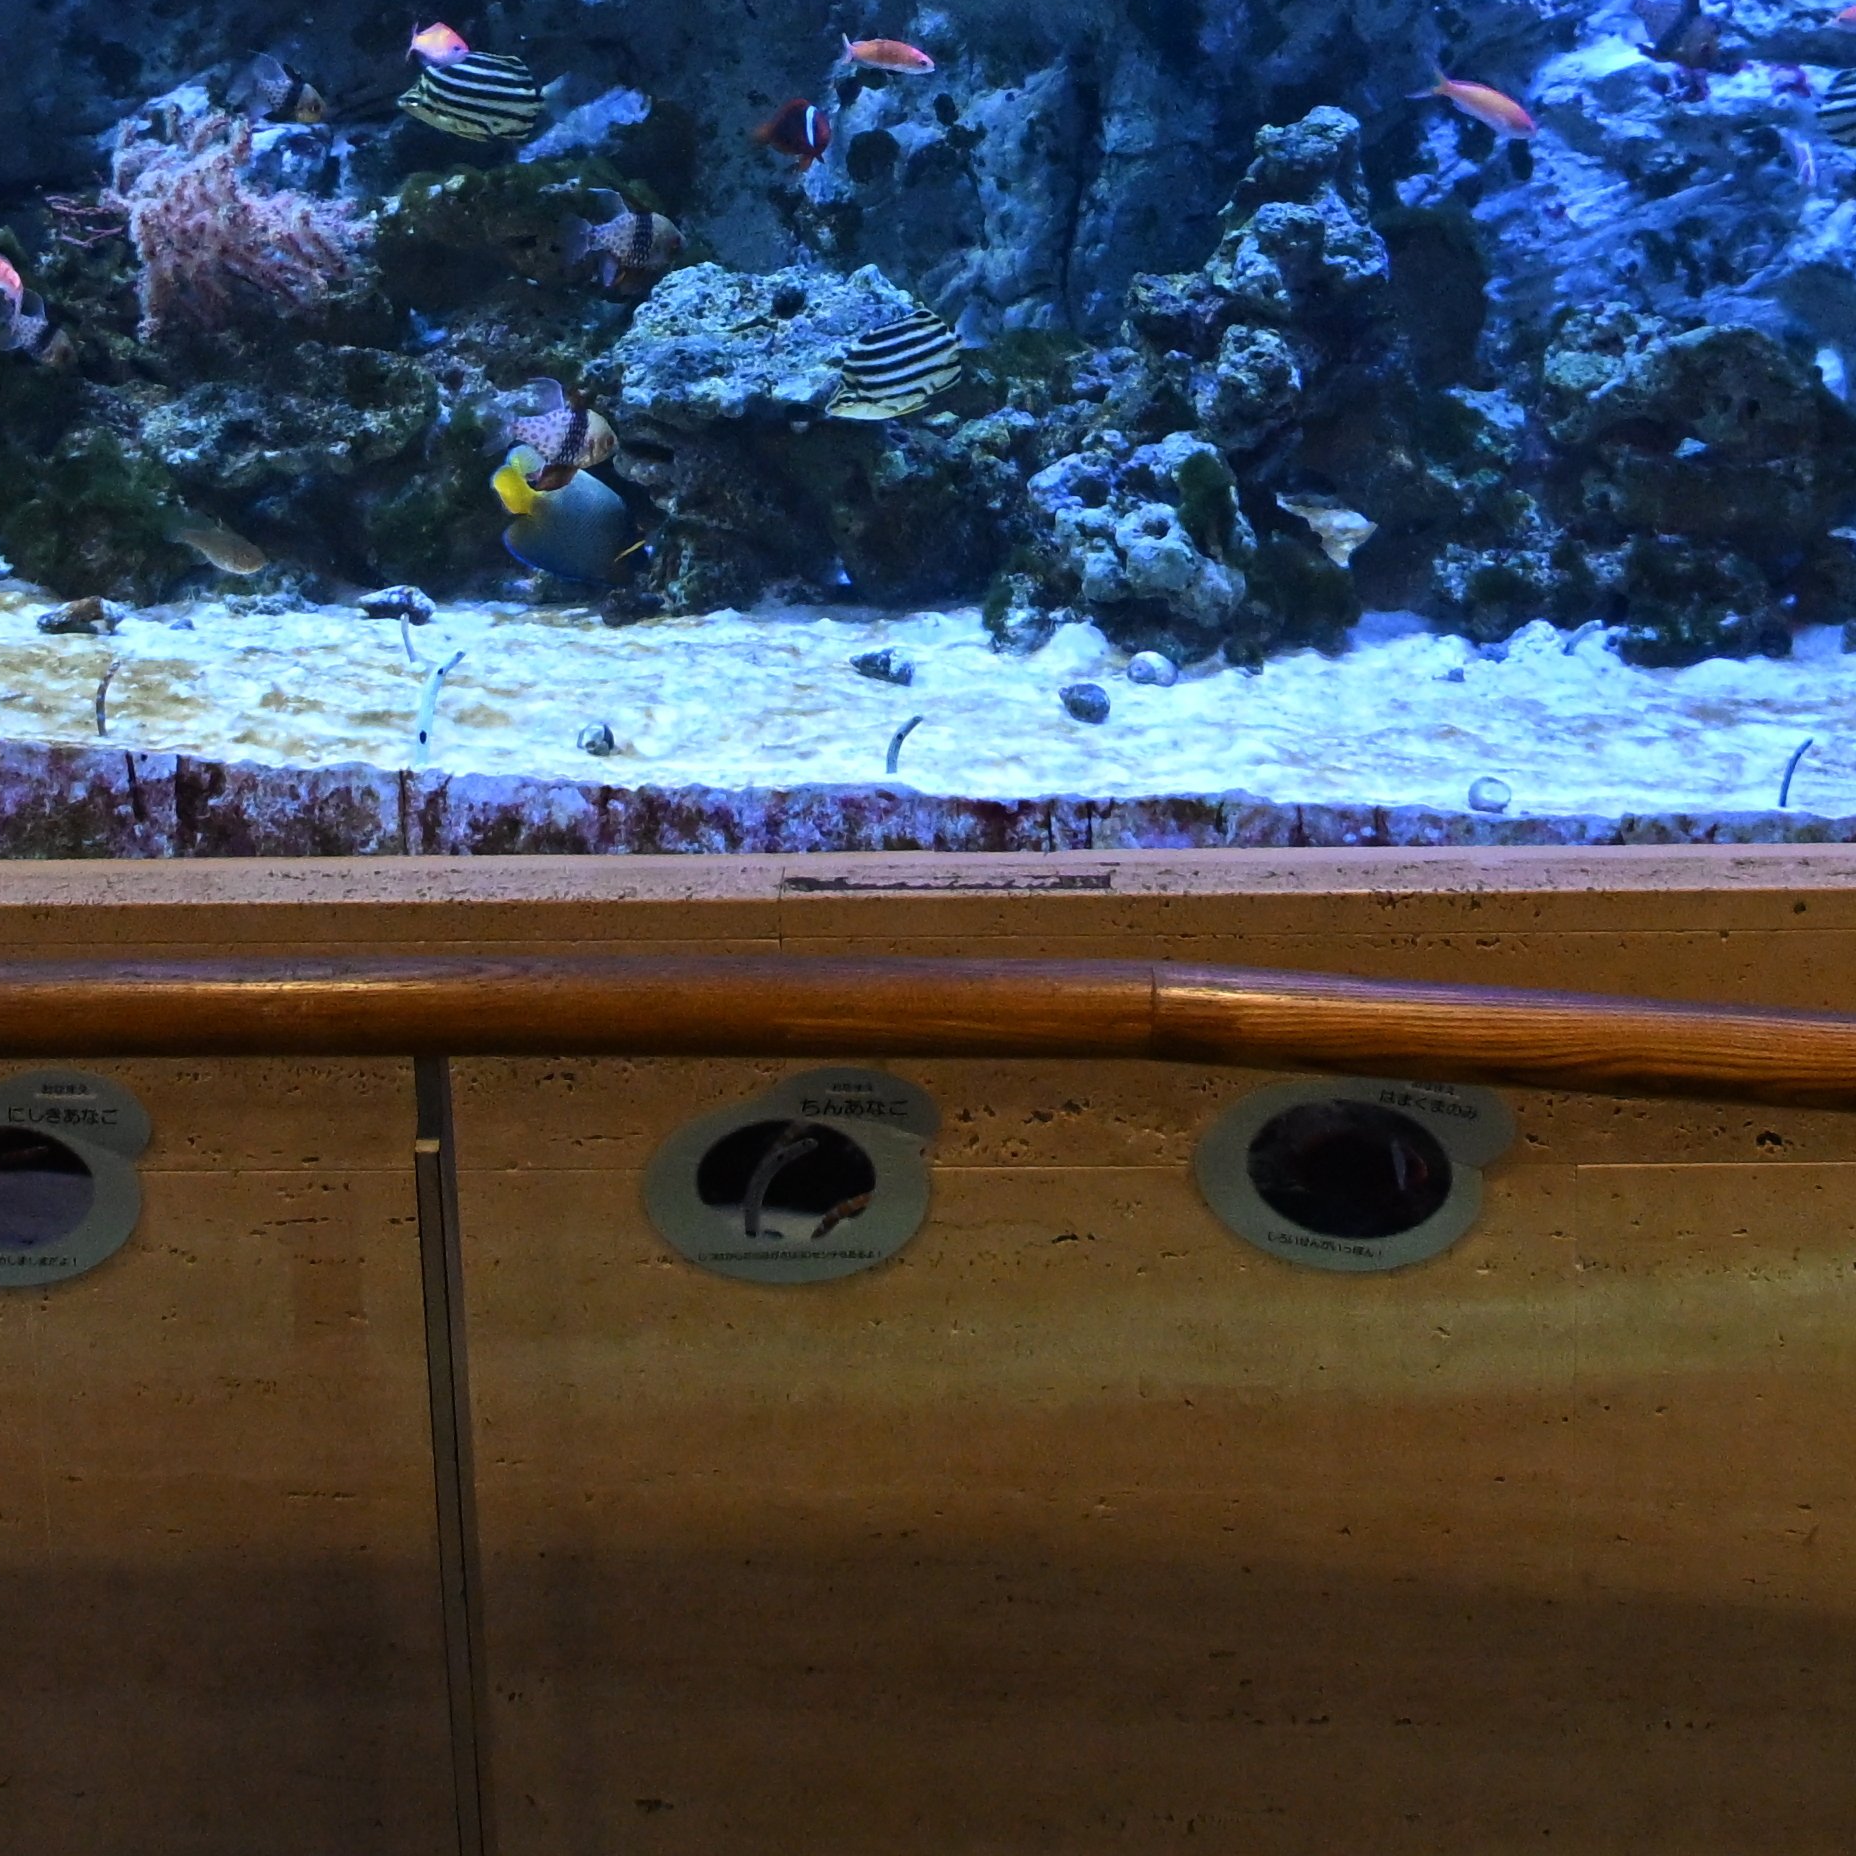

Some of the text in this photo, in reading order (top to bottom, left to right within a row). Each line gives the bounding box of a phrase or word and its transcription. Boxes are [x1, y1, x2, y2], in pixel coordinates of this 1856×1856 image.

[1380, 1089, 1478, 1120] はまくまのみ
